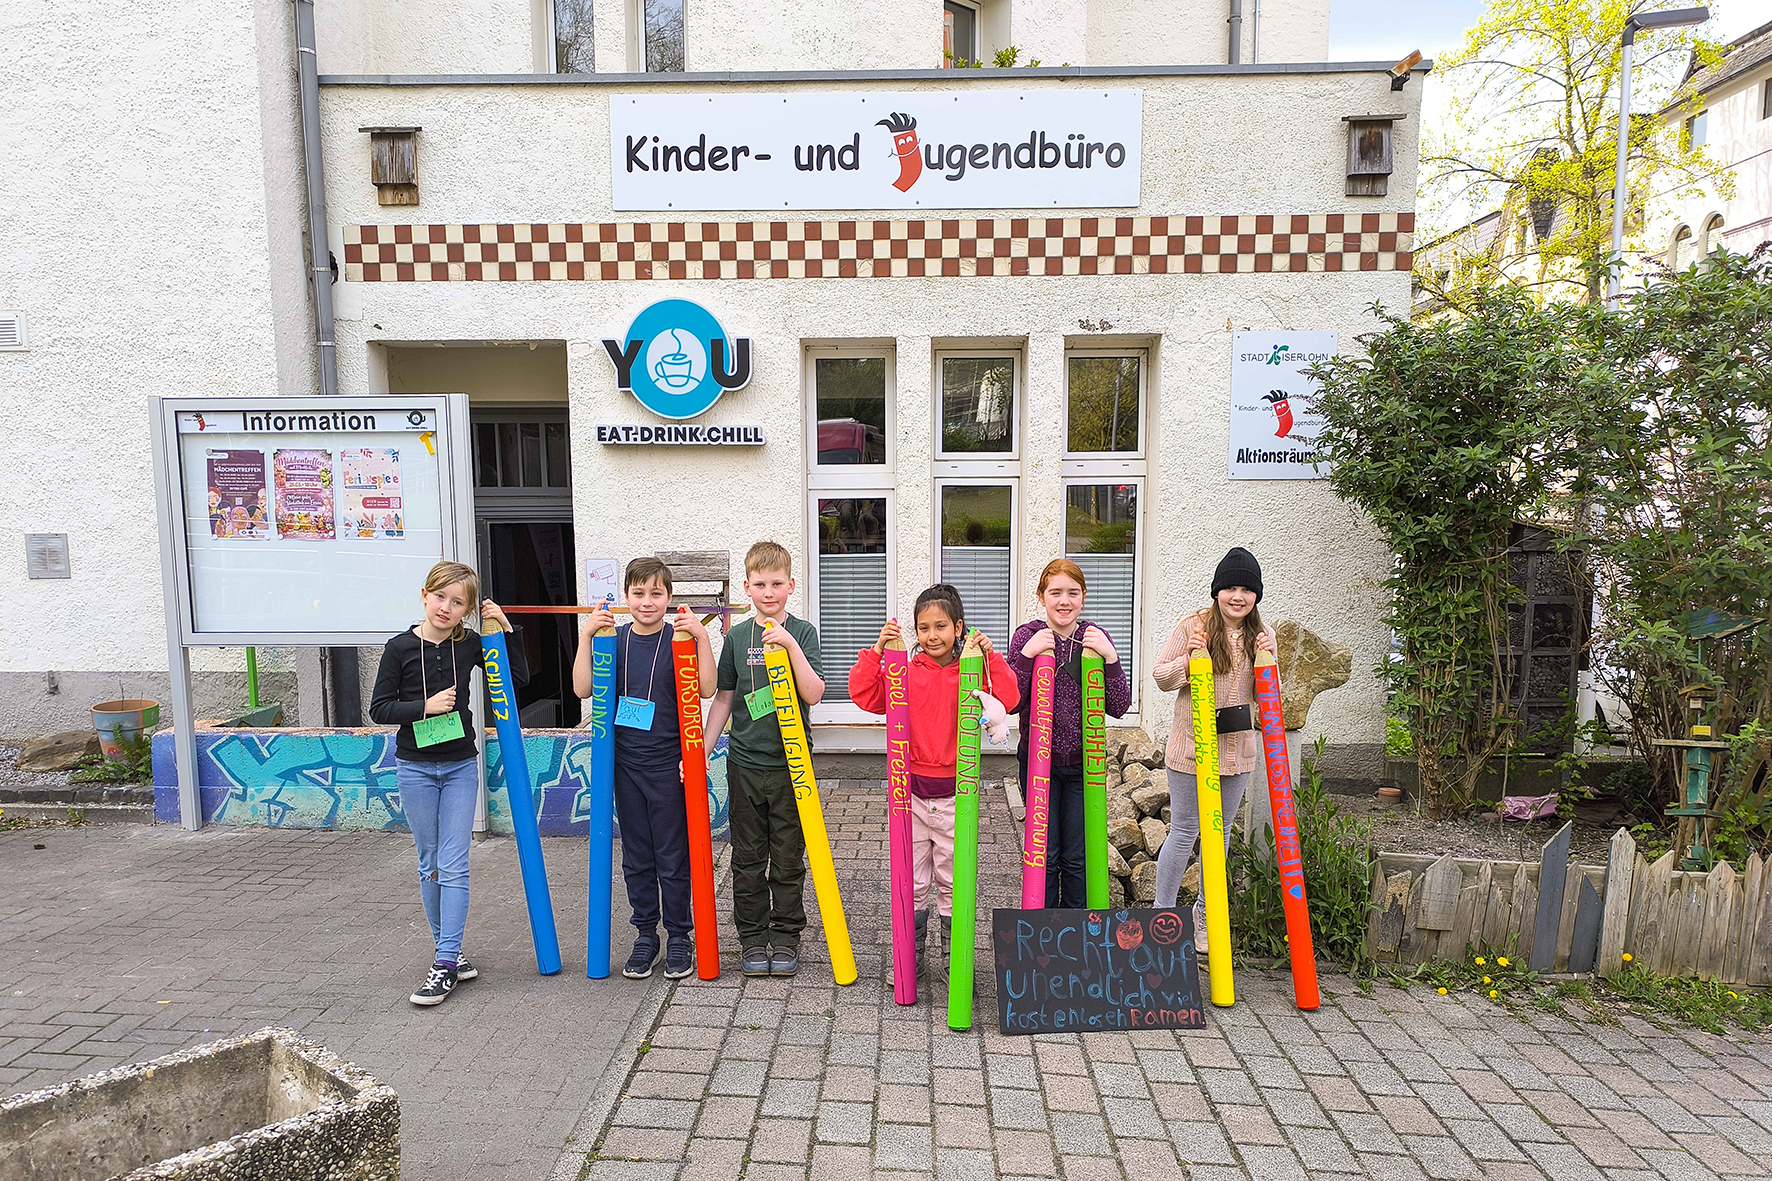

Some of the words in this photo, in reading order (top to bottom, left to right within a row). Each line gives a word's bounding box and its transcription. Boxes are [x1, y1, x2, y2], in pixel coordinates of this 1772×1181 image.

[626, 134, 771, 173] Kinder-
[793, 133, 860, 171] und
[602, 299, 750, 417] YOU
[1240, 353, 1269, 362] STADT
[1281, 352, 1329, 362] ISERLOHN
[242, 411, 376, 432] Information
[1238, 404, 1260, 412] Kinder-
[1236, 447, 1323, 464] Aktionsräum
[482, 648, 509, 721] SCHUTZ
[591, 650, 613, 739] BILDUNG
[676, 653, 704, 752] FÜRSORGE
[885, 662, 908, 710] Spiel
[1031, 666, 1054, 763] Gewaltfreie
[1191, 673, 1209, 767] Kinderrechte
[956, 672, 980, 796] ERHOLUNG
[1086, 669, 1106, 792] GLEICHHEIT
[890, 739, 912, 817] Freizeit
[1023, 775, 1050, 868] Erziehung
[1212, 809, 1222, 836] der
[1016, 916, 1124, 979] Recht
[1129, 940, 1195, 985] auf
[1160, 991, 1200, 1006] viel
